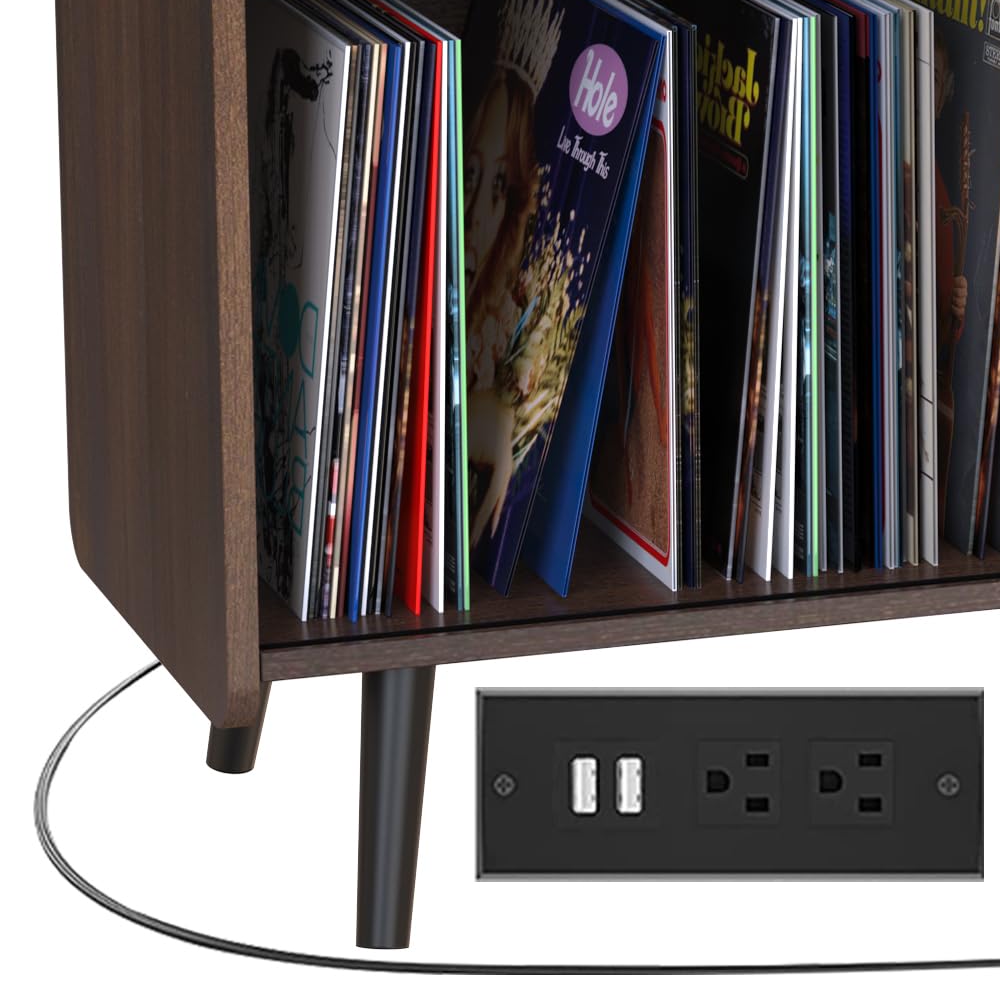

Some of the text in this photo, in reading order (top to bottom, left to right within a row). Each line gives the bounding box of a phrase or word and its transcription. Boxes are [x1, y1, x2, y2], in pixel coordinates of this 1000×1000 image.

[574, 48, 618, 128] Hole
[556, 125, 610, 180] Live Through This
